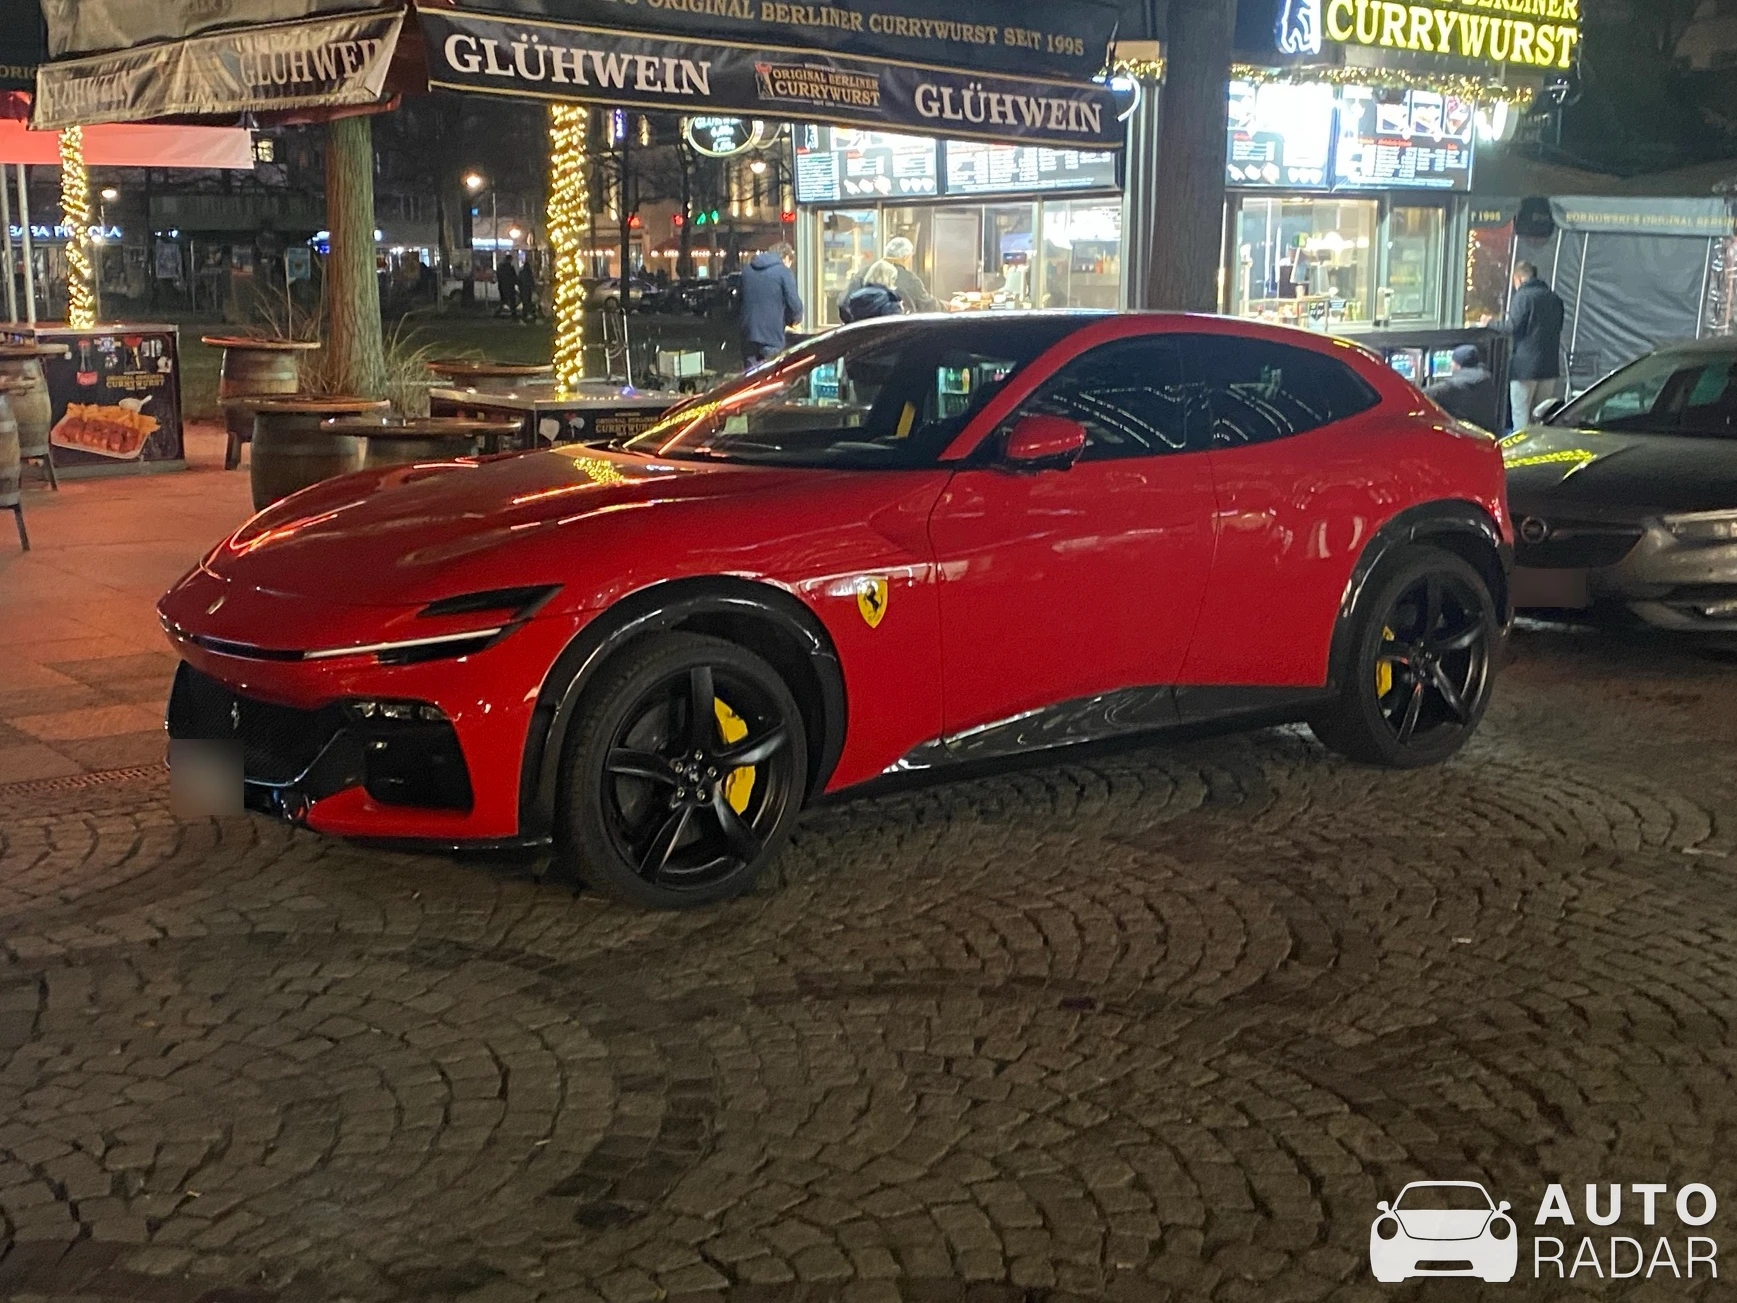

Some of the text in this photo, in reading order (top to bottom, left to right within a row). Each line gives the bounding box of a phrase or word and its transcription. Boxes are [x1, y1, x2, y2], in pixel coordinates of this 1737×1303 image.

[761, 2, 863, 31] BERLINER
[869, 13, 998, 45] CURRYWURST
[1003, 27, 1042, 50] SEIT
[1046, 34, 1085, 57] 1995
[1461, 0, 1577, 20] LINER
[1326, 0, 1578, 68] CURRYWURST
[444, 33, 711, 95] GLÜHWEIN
[772, 68, 879, 90] ORIGINAL BERLINER
[774, 80, 880, 107] CURRYWURST
[914, 81, 1102, 133] GLÜHWEIN
[595, 423, 653, 433] CURRYWUR
